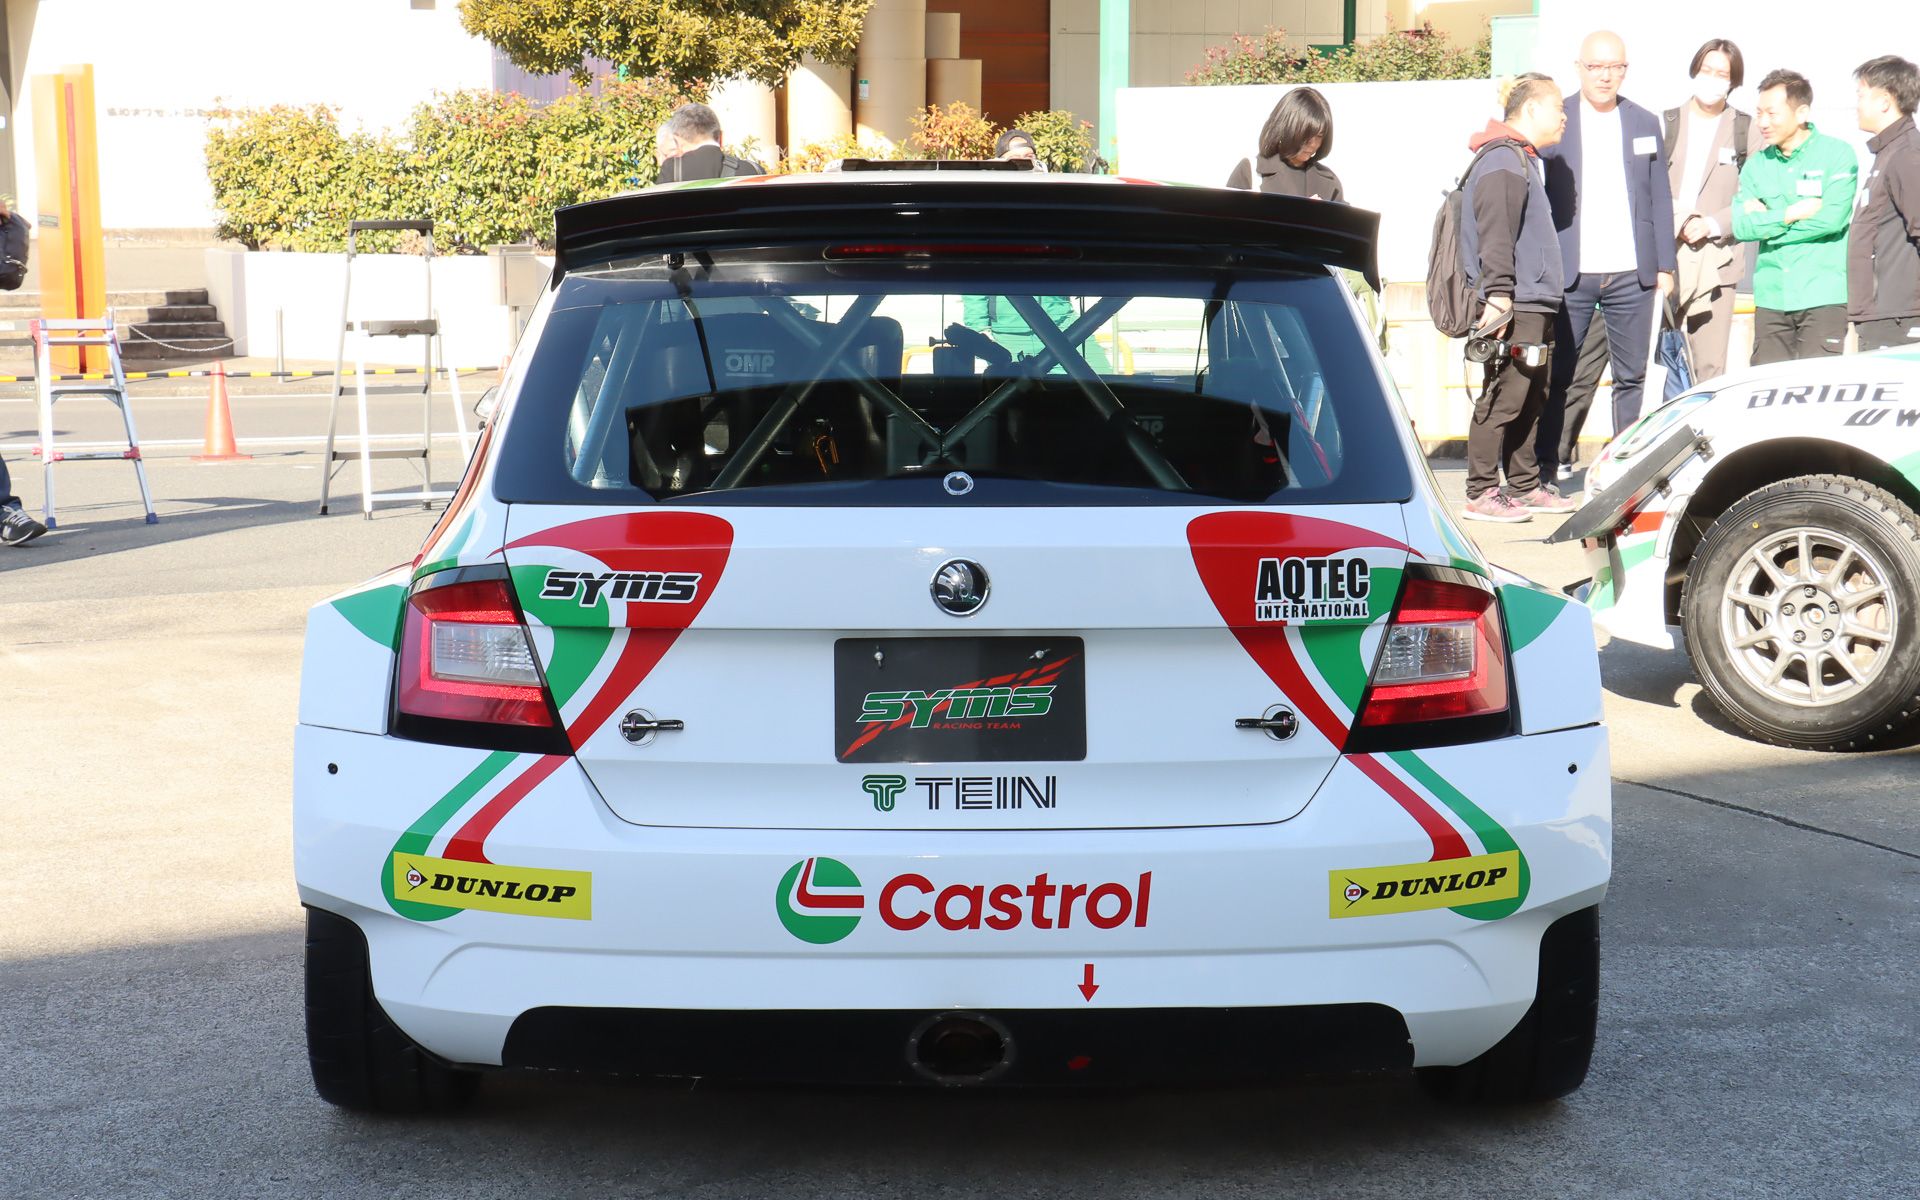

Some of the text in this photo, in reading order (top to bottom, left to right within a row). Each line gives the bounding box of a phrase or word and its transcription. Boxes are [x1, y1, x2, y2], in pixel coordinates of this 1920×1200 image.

[725, 353, 775, 373] OMP
[1747, 382, 1904, 409] BRIDE
[1257, 557, 1369, 604] AQTEC
[1257, 603, 1368, 619] INTERNATIONAL
[933, 722, 983, 730] RACING
[915, 776, 1057, 810] TEIN
[430, 873, 576, 903] DUNLOP
[1371, 867, 1508, 900] DUNLOP
[879, 871, 1152, 931] Castrol
